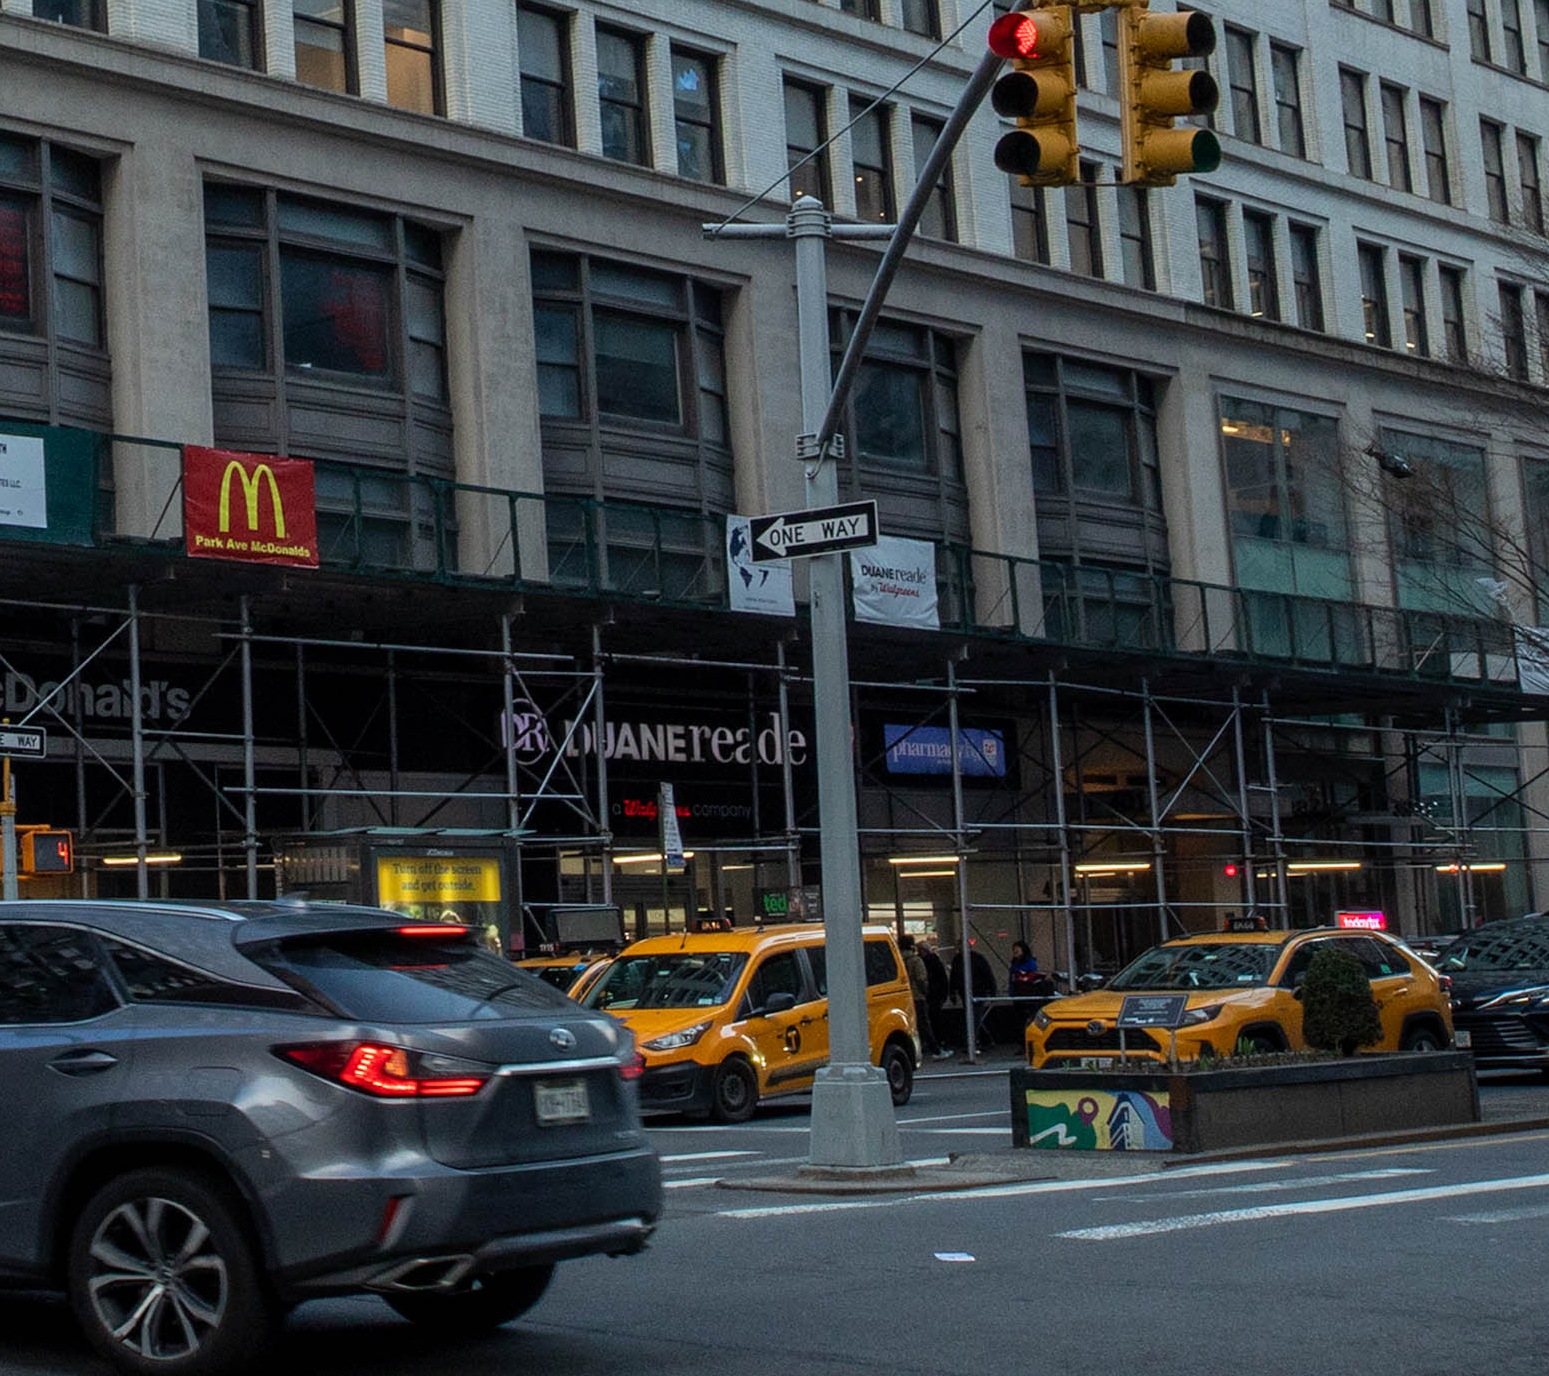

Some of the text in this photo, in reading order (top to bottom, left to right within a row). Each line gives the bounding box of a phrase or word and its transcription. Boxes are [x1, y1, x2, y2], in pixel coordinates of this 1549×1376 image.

[770, 517, 860, 546] ONE WAY
[195, 535, 311, 558] Park Ave McDonalds
[880, 582, 921, 599] Walgreens
[18, 735, 38, 748] WAY
[693, 803, 752, 817] company
[57, 841, 69, 865] 4
[393, 862, 482, 875] Turn off the screen
[402, 879, 476, 893] and get outside.
[763, 894, 788, 913] ted
